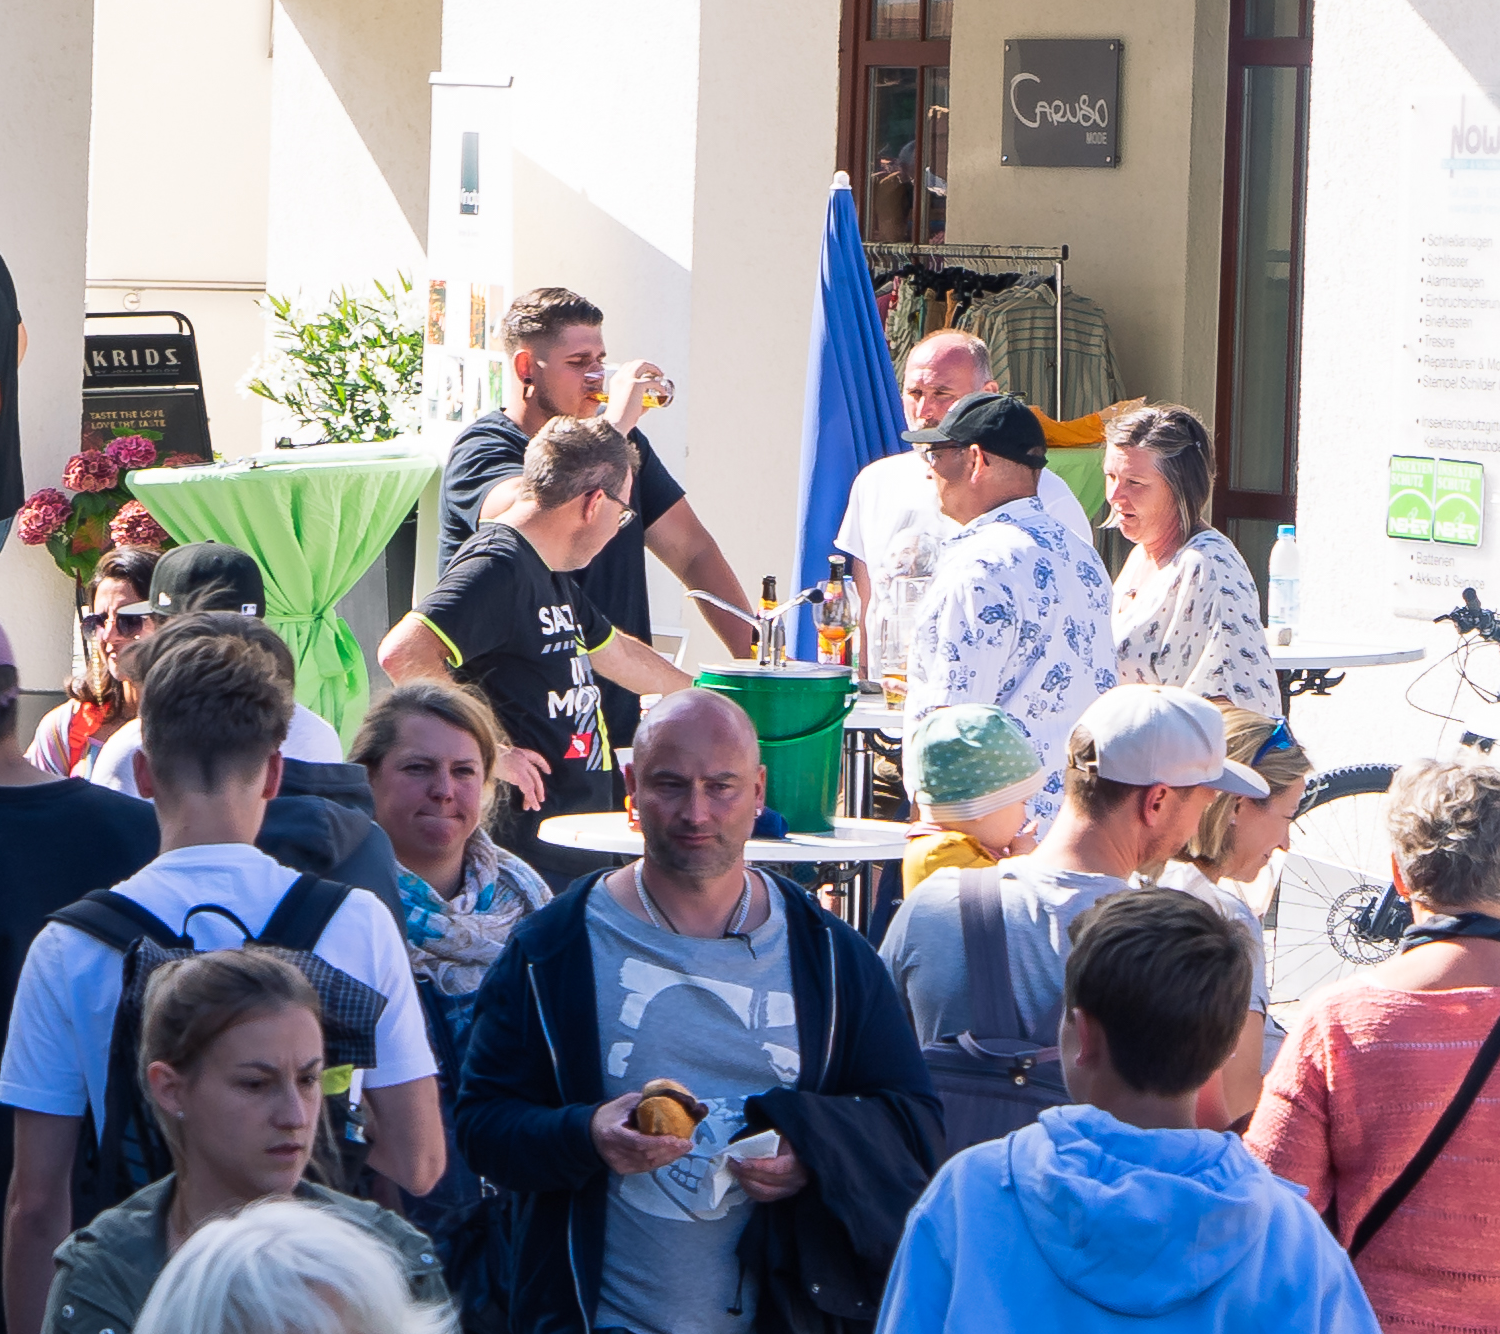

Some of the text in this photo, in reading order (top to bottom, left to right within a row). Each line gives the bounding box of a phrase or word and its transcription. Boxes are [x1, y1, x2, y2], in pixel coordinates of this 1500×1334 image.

[1085, 131, 1108, 145] MODE
[90, 409, 165, 420] TASTE THE LOVE
[91, 419, 167, 430] LOVE THE TASTE
[1391, 460, 1433, 475] INSEKTEN
[1437, 463, 1481, 479] INSEKTEN
[1390, 472, 1424, 488] SCHUTZ
[1437, 476, 1471, 493] SCHUTZ
[1389, 516, 1430, 536] NEHER
[1435, 521, 1477, 541] NEHER
[1416, 551, 1455, 567] Batterien
